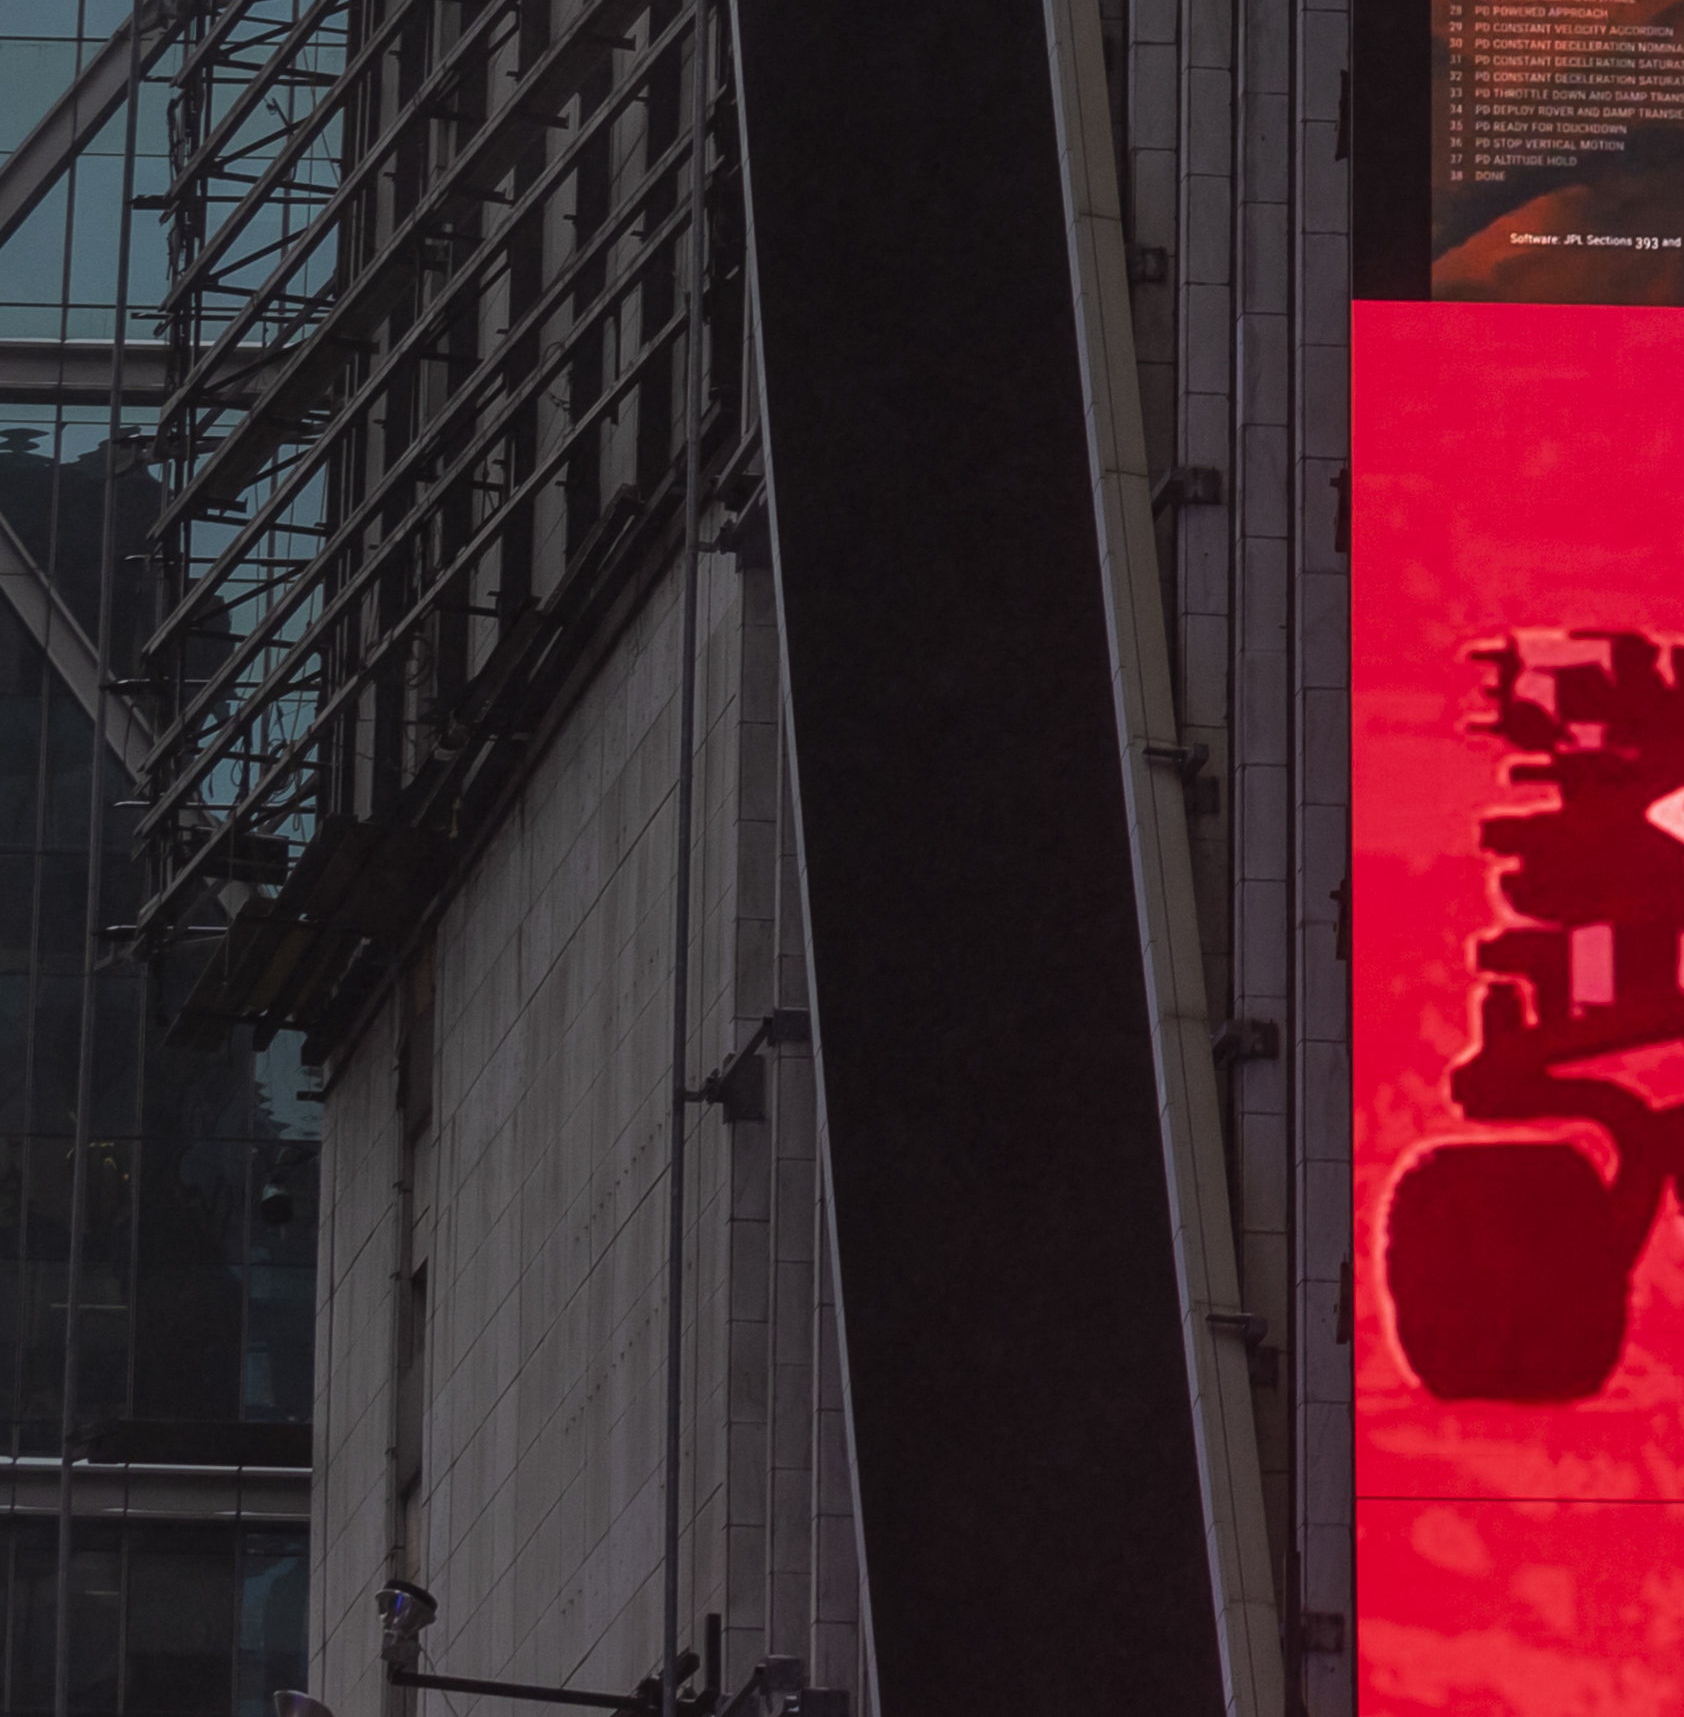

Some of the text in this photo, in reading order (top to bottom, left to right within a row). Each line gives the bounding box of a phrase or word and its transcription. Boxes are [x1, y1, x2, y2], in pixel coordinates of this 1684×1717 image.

[1563, 234, 1584, 246] JPL
[1586, 234, 1632, 247] Sections
[1635, 237, 1659, 250] 393
[1662, 236, 1682, 248] and
